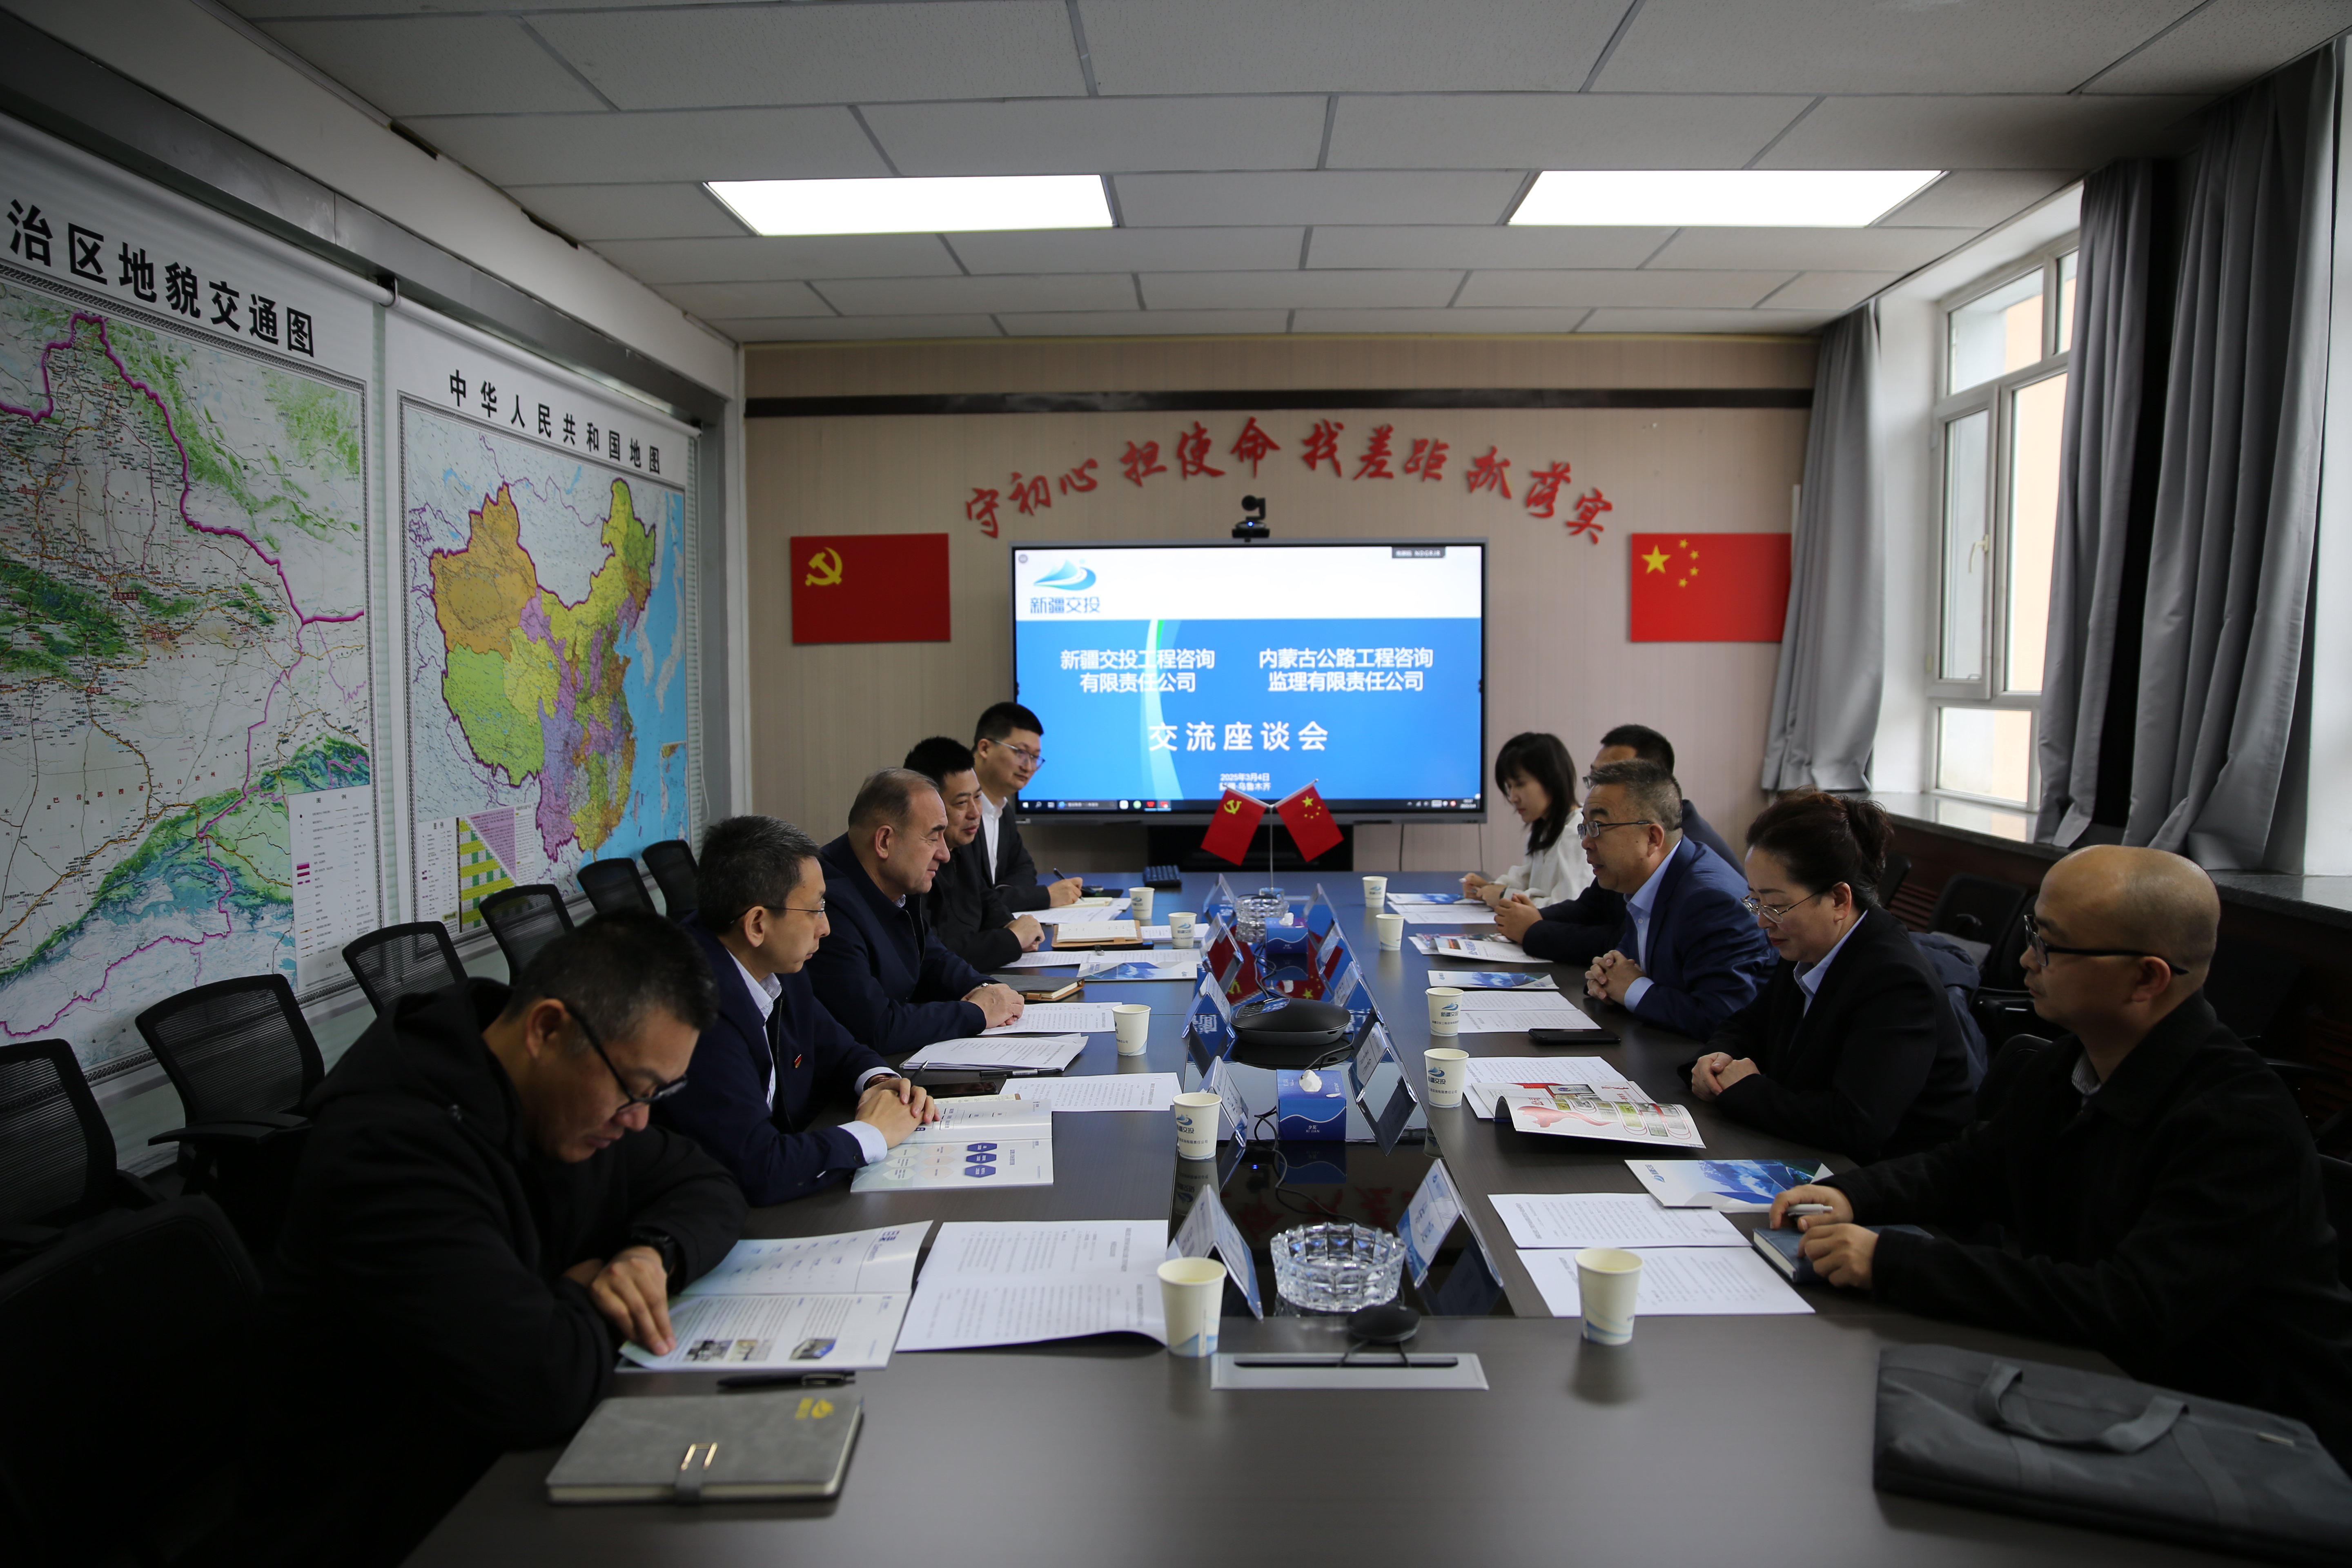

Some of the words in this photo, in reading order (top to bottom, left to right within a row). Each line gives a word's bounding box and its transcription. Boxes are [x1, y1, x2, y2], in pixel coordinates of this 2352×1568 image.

[7, 198, 314, 357] 治区地貌交通图
[450, 369, 660, 474] 中华人民共和国地图
[966, 459, 1098, 537] 守初心
[1121, 417, 1280, 486] 担使命
[1302, 420, 1450, 481] 找差距
[1467, 446, 1613, 544] 抓落实
[1030, 597, 1100, 614] 新疆交投
[1060, 648, 1215, 669] 新疆交投工程咨询
[1259, 647, 1434, 668] 内蒙古公路工程咨询
[1080, 672, 1196, 693] 有限责任公司
[1268, 670, 1424, 692] 监理有限责任公司
[1149, 721, 1328, 751] 交流座谈会
[1220, 773, 1270, 782] 2025年3月4日
